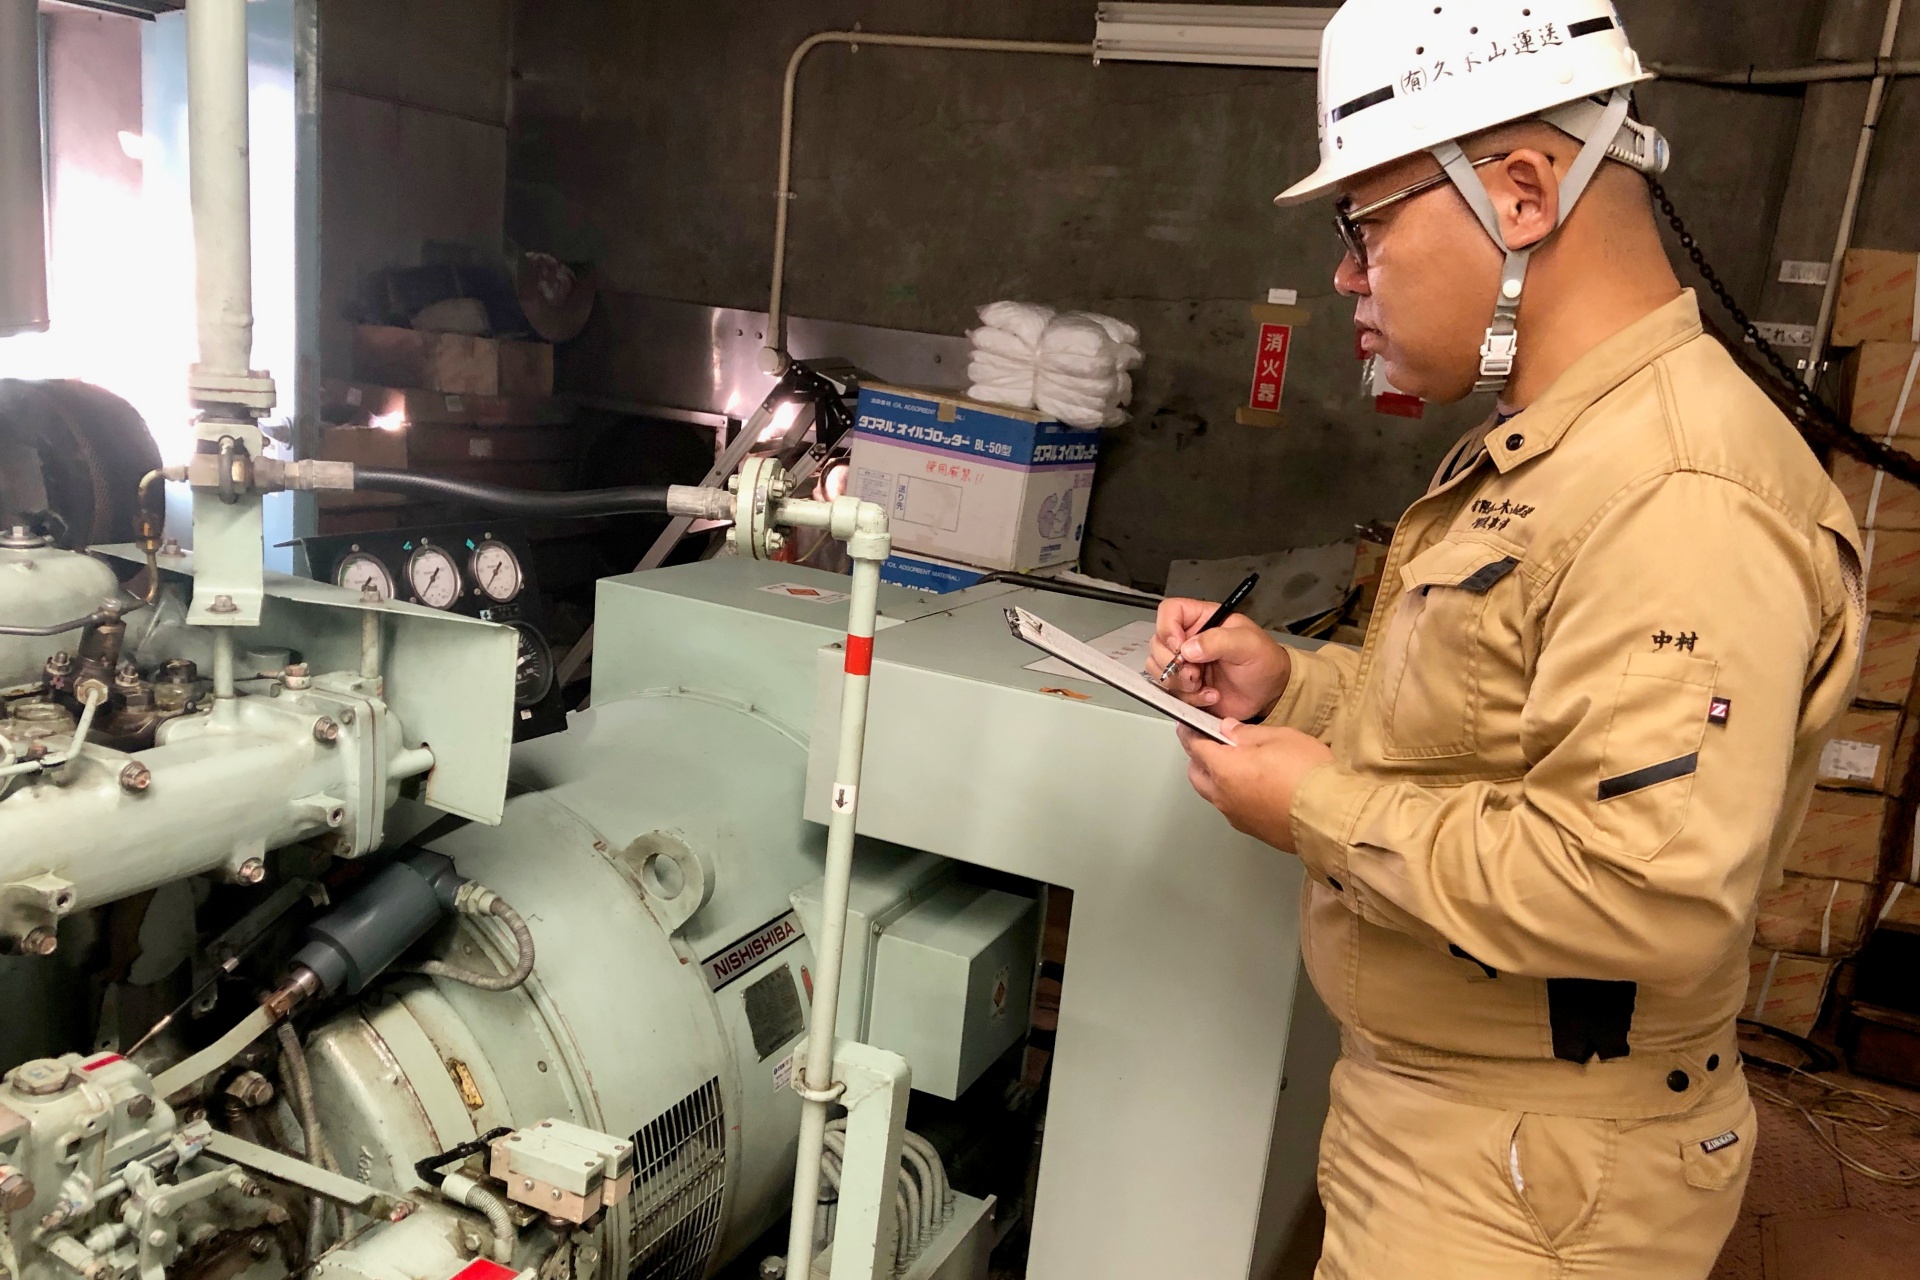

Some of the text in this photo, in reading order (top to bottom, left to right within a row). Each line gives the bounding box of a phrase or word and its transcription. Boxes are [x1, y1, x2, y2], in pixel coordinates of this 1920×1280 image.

[1257, 333, 1285, 403] 消火器
[974, 438, 1013, 457] BL-50型
[1651, 629, 1699, 655] 中村
[1710, 702, 1728, 718] Z
[713, 921, 796, 980] NISHISHIBA
